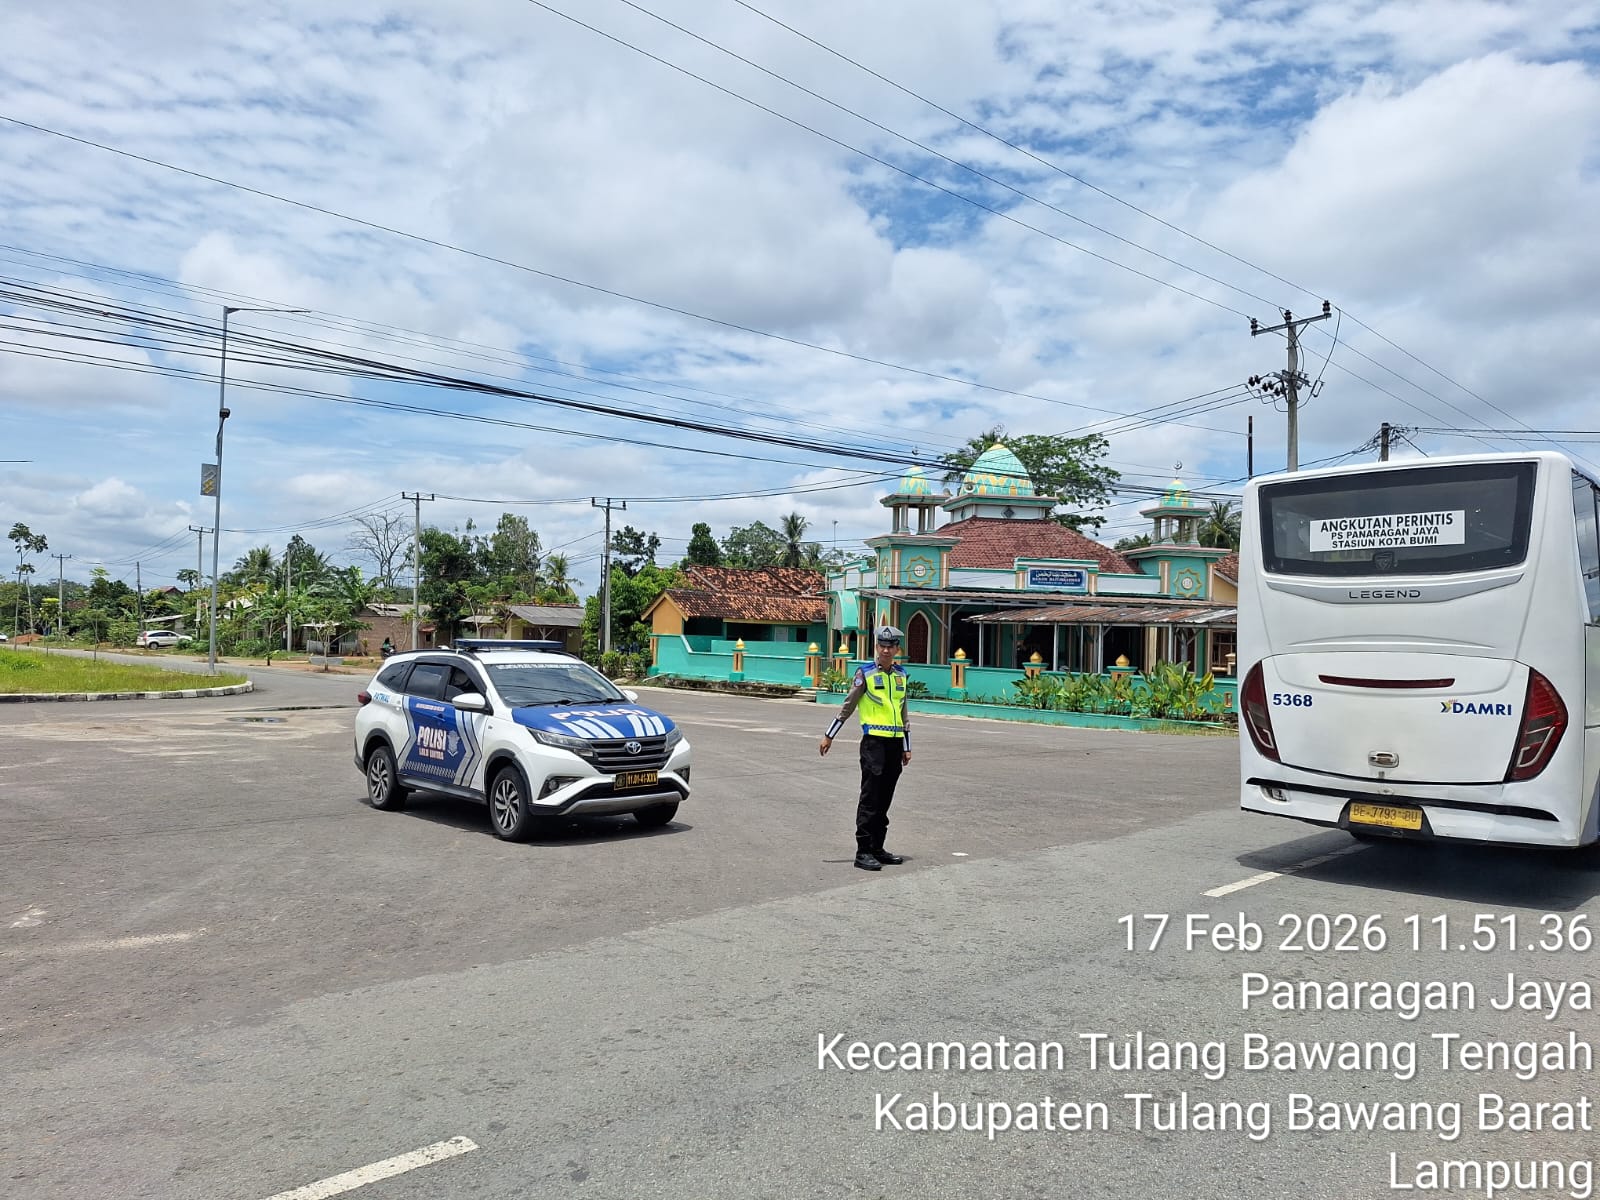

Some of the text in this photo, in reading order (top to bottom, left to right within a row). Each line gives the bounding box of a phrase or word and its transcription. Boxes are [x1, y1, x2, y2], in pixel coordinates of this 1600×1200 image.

[1320, 512, 1454, 532] ANGKUTAN PERINTIS
[1331, 526, 1440, 540] PS PANARAGAN JAYA
[1332, 535, 1437, 549] STASIUN KOTA BUMI
[1348, 590, 1421, 599] LEGEND
[1272, 693, 1313, 707] 5368
[550, 709, 647, 720] POLISI
[1452, 702, 1512, 716] DAMRI
[417, 726, 446, 751] POLISI
